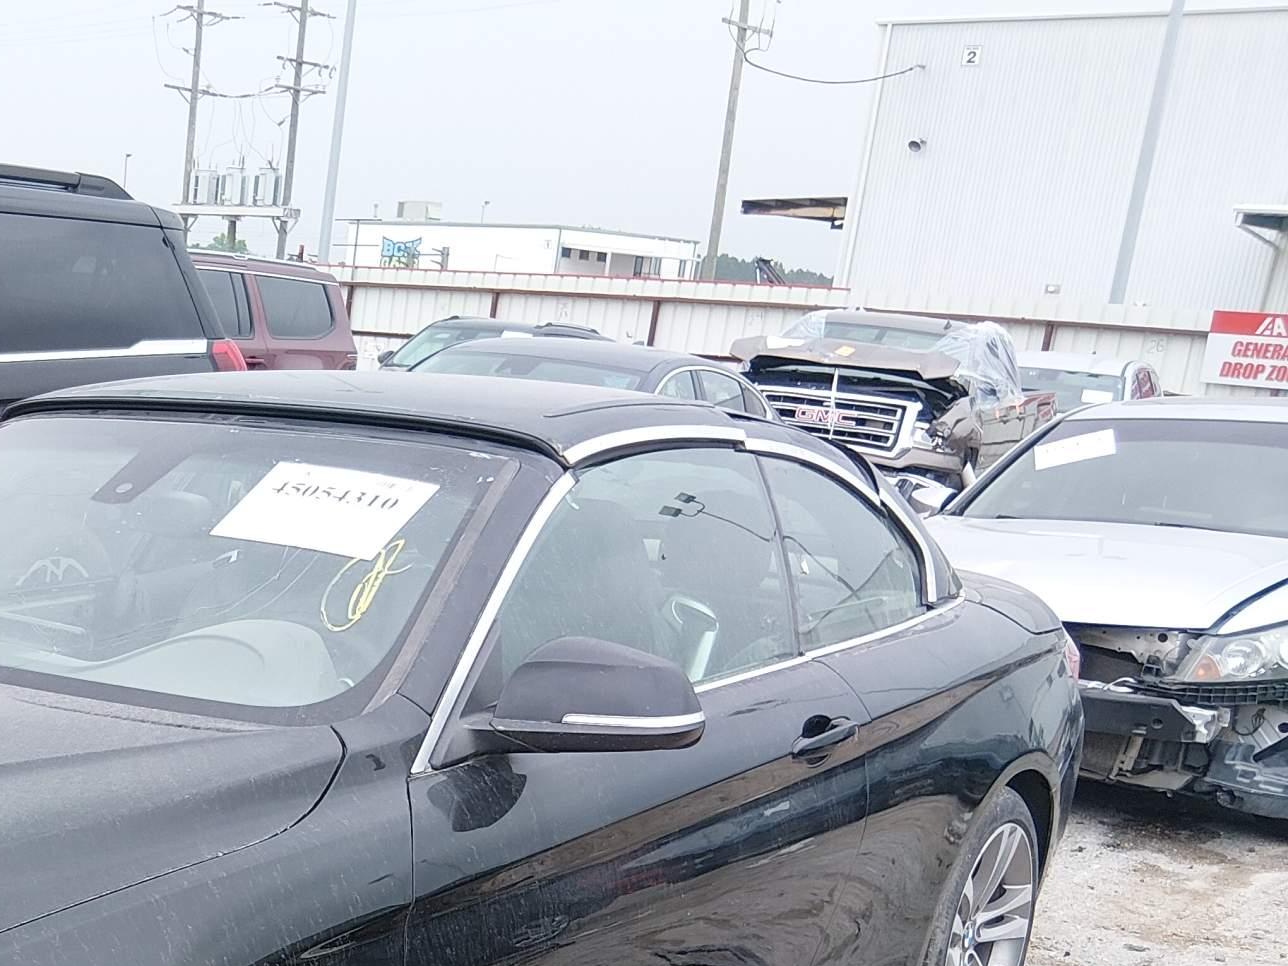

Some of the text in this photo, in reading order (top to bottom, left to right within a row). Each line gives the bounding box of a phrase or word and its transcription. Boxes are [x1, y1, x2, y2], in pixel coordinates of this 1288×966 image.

[966, 51, 977, 63] 2
[1219, 361, 1288, 383] DROP ZO
[795, 405, 858, 428] GMC
[271, 480, 400, 511] 45054310
